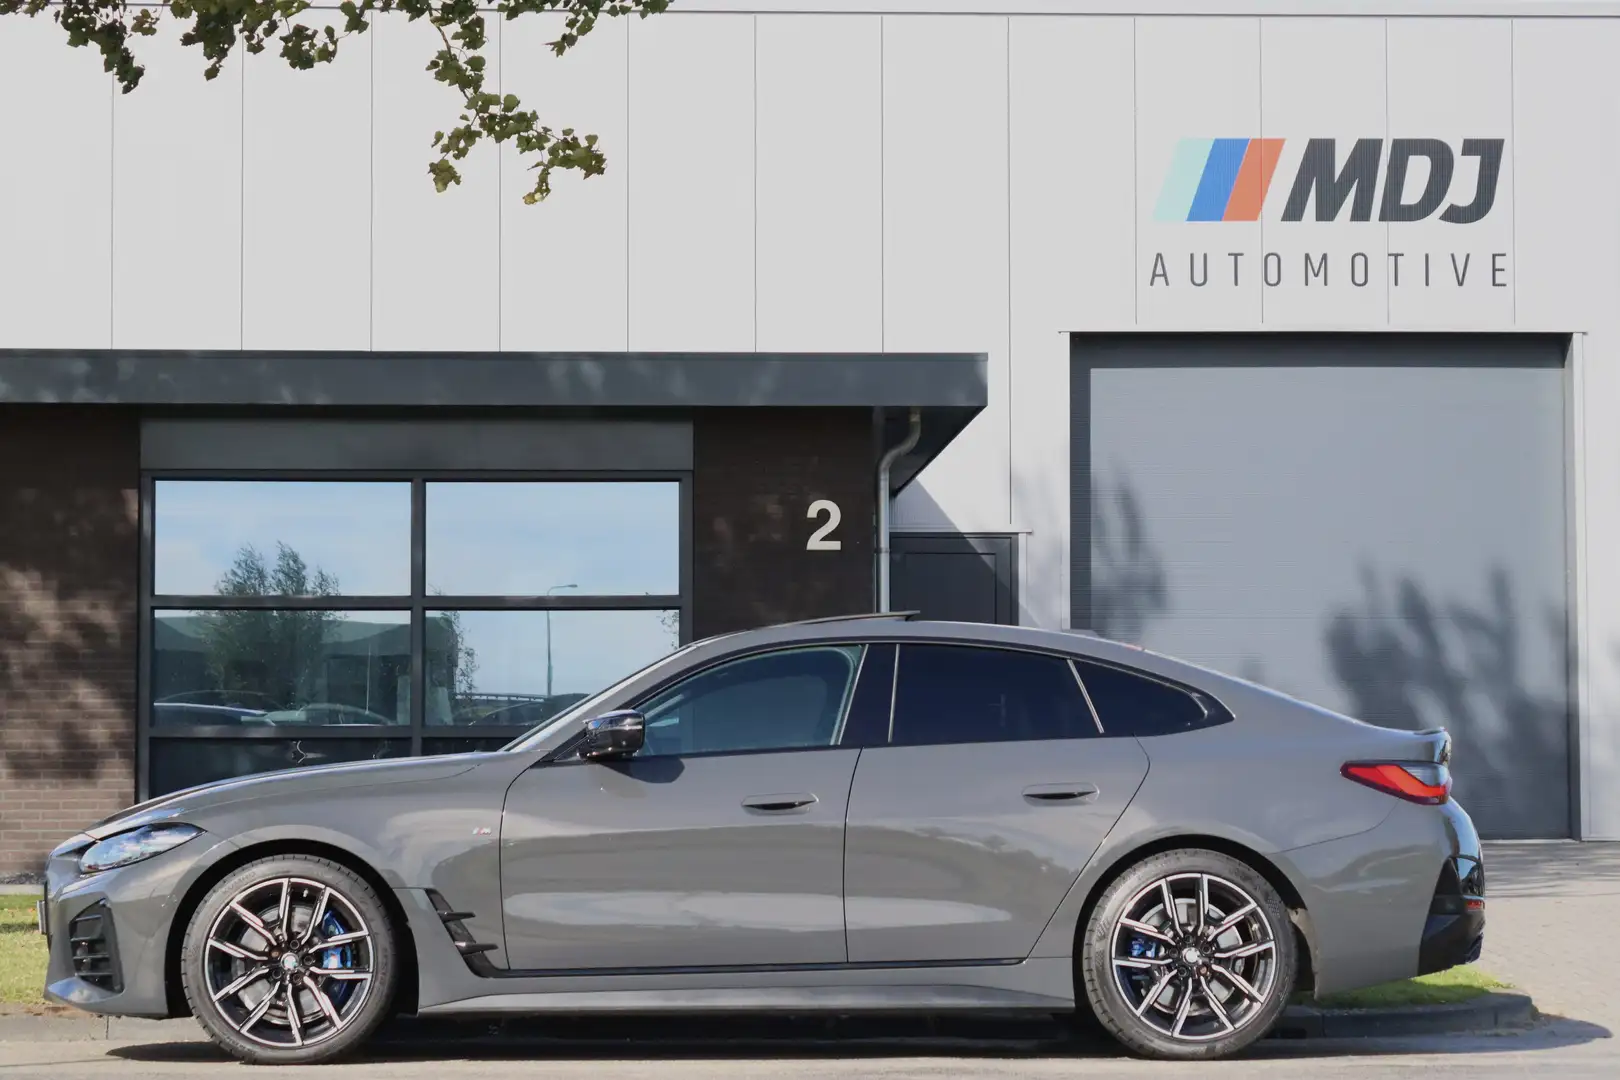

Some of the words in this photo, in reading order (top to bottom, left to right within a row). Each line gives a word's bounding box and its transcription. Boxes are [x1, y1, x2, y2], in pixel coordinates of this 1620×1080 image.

[1280, 138, 1505, 224] MDJ
[1149, 252, 1507, 287] AUTOMOTIVE
[806, 499, 842, 551] 2
